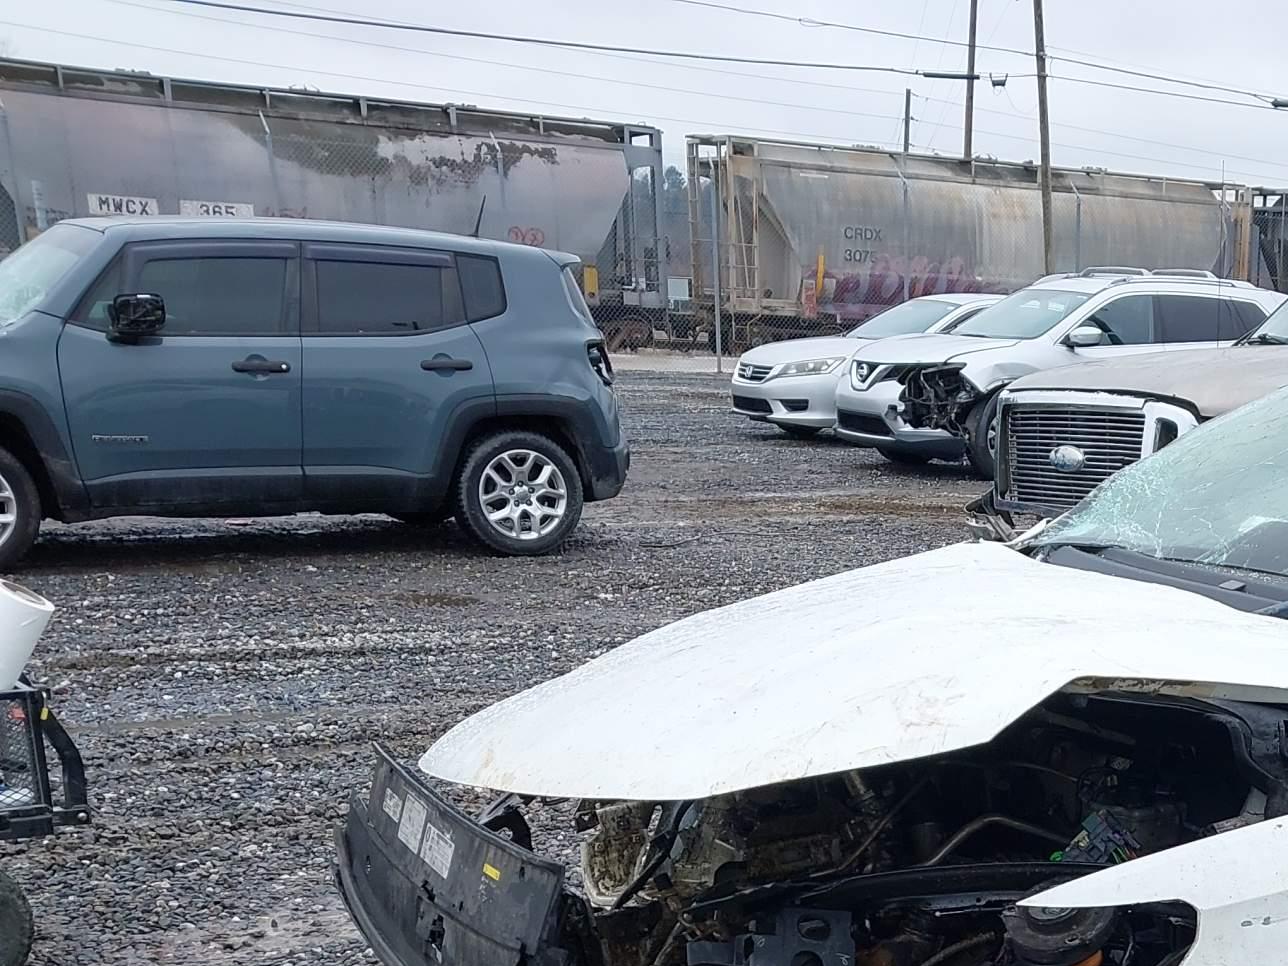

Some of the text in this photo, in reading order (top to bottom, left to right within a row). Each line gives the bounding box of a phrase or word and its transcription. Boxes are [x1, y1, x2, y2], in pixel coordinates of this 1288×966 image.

[98, 196, 236, 216] MWCX 365
[844, 226, 882, 241] CRDX
